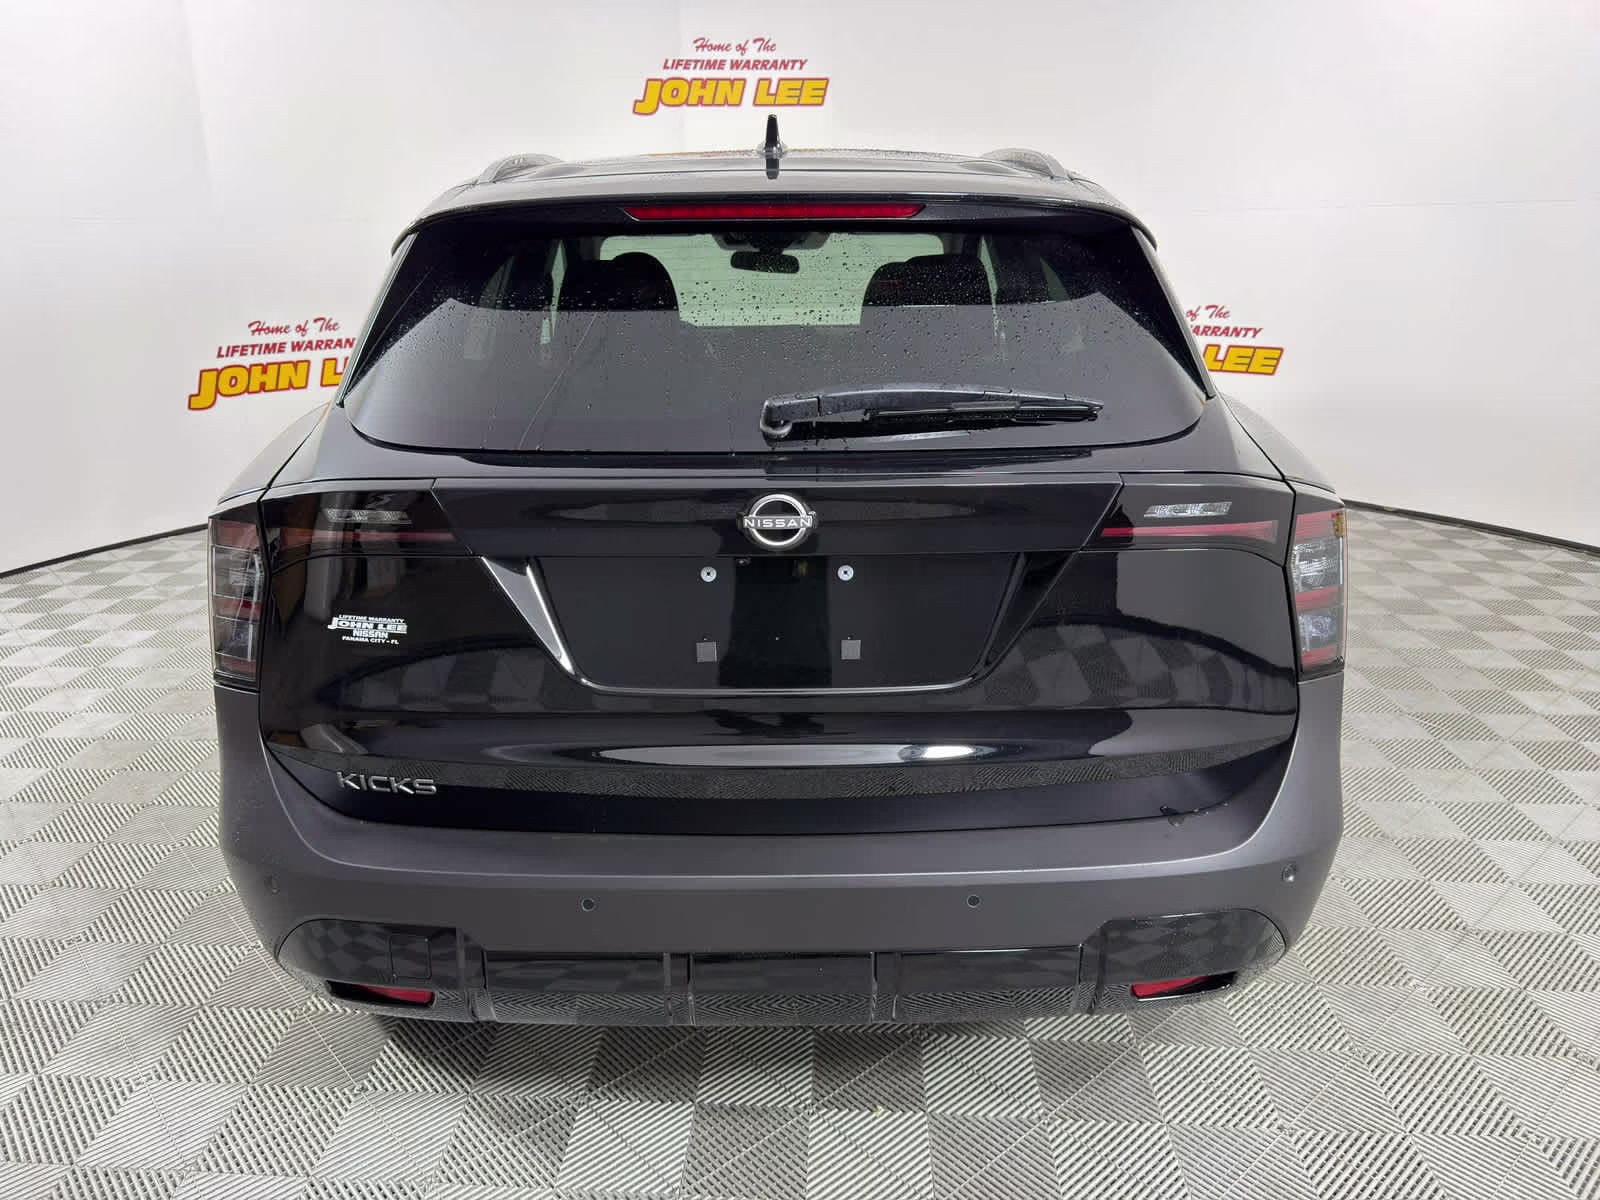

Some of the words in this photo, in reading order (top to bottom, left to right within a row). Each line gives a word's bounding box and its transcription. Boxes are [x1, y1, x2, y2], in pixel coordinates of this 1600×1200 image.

[693, 37, 733, 53] Home
[735, 39, 749, 56] of
[752, 37, 777, 53] The
[663, 58, 725, 71] LIFETIME
[729, 58, 808, 71] WARRANTY
[632, 77, 747, 115] JOHN
[752, 77, 829, 107] LEE
[1185, 305, 1201, 322] of
[1204, 304, 1231, 319] The
[247, 320, 291, 336] Home
[295, 320, 309, 337] of
[313, 317, 340, 333] The
[1190, 325, 1264, 338] ARRANTY
[216, 341, 286, 358] LIFETIME
[1202, 343, 1284, 376] LEE
[187, 359, 311, 411] JOHN
[743, 517, 812, 528] NISSAN
[327, 617, 374, 630] JOHN
[377, 622, 408, 633] LEE
[342, 635, 369, 643] PANAMA
[352, 629, 389, 639] NISSAN
[336, 771, 437, 795] KICKS
